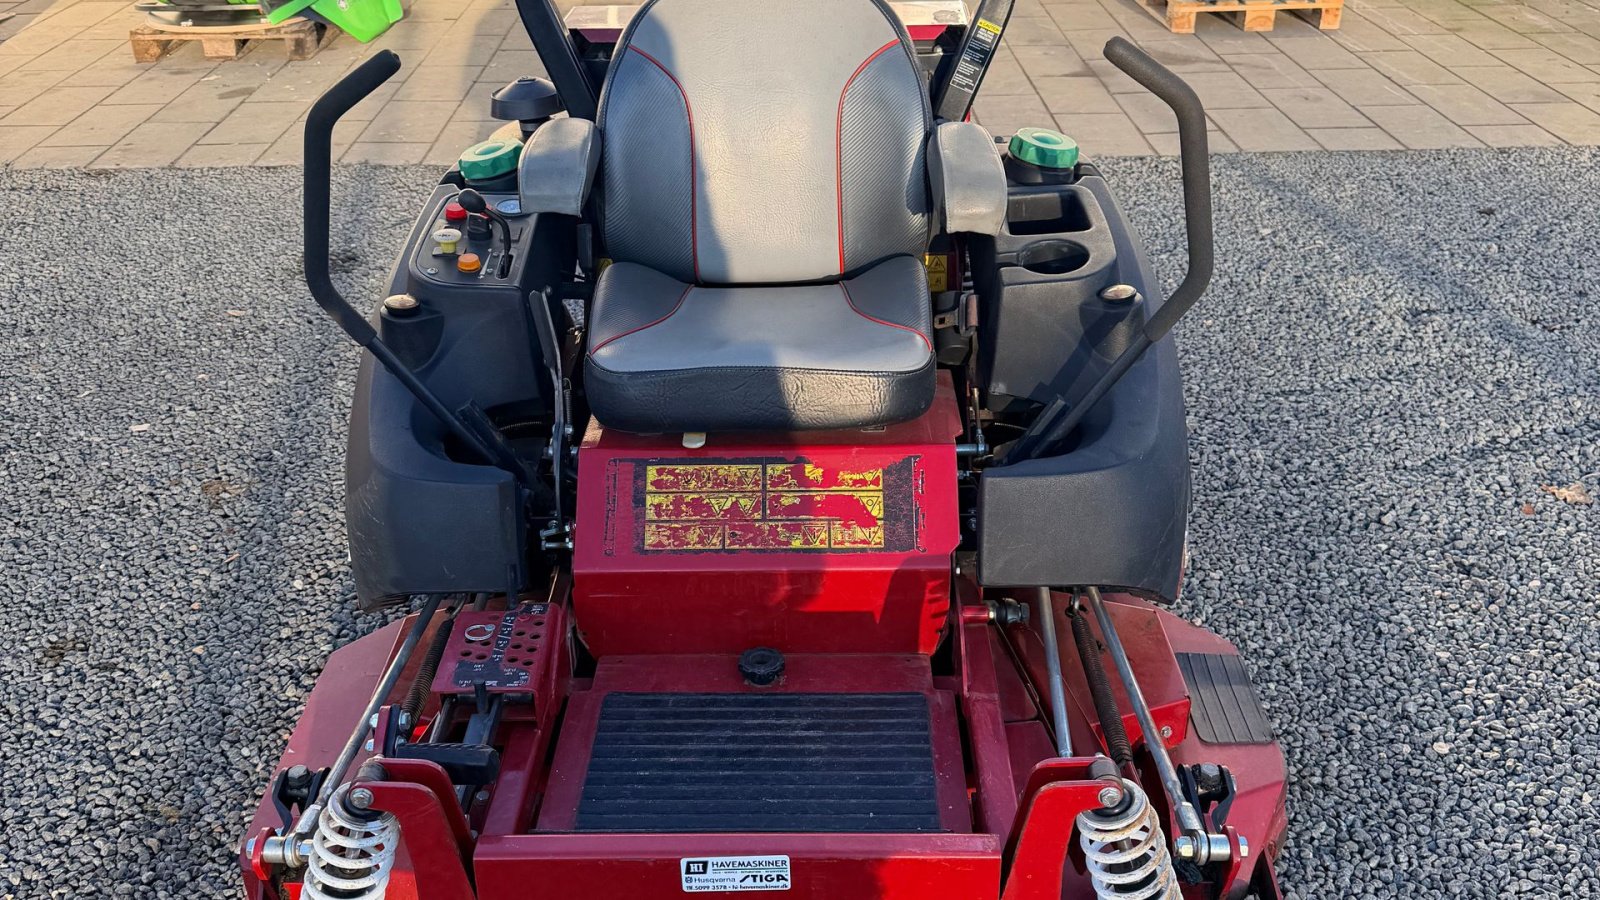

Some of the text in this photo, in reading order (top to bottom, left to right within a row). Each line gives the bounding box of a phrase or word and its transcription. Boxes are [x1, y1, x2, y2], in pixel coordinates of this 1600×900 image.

[689, 863, 704, 873] HI
[711, 860, 787, 868] HAVEMASKINER
[694, 876, 736, 884] Husqvarna
[739, 874, 789, 883] STIGA
